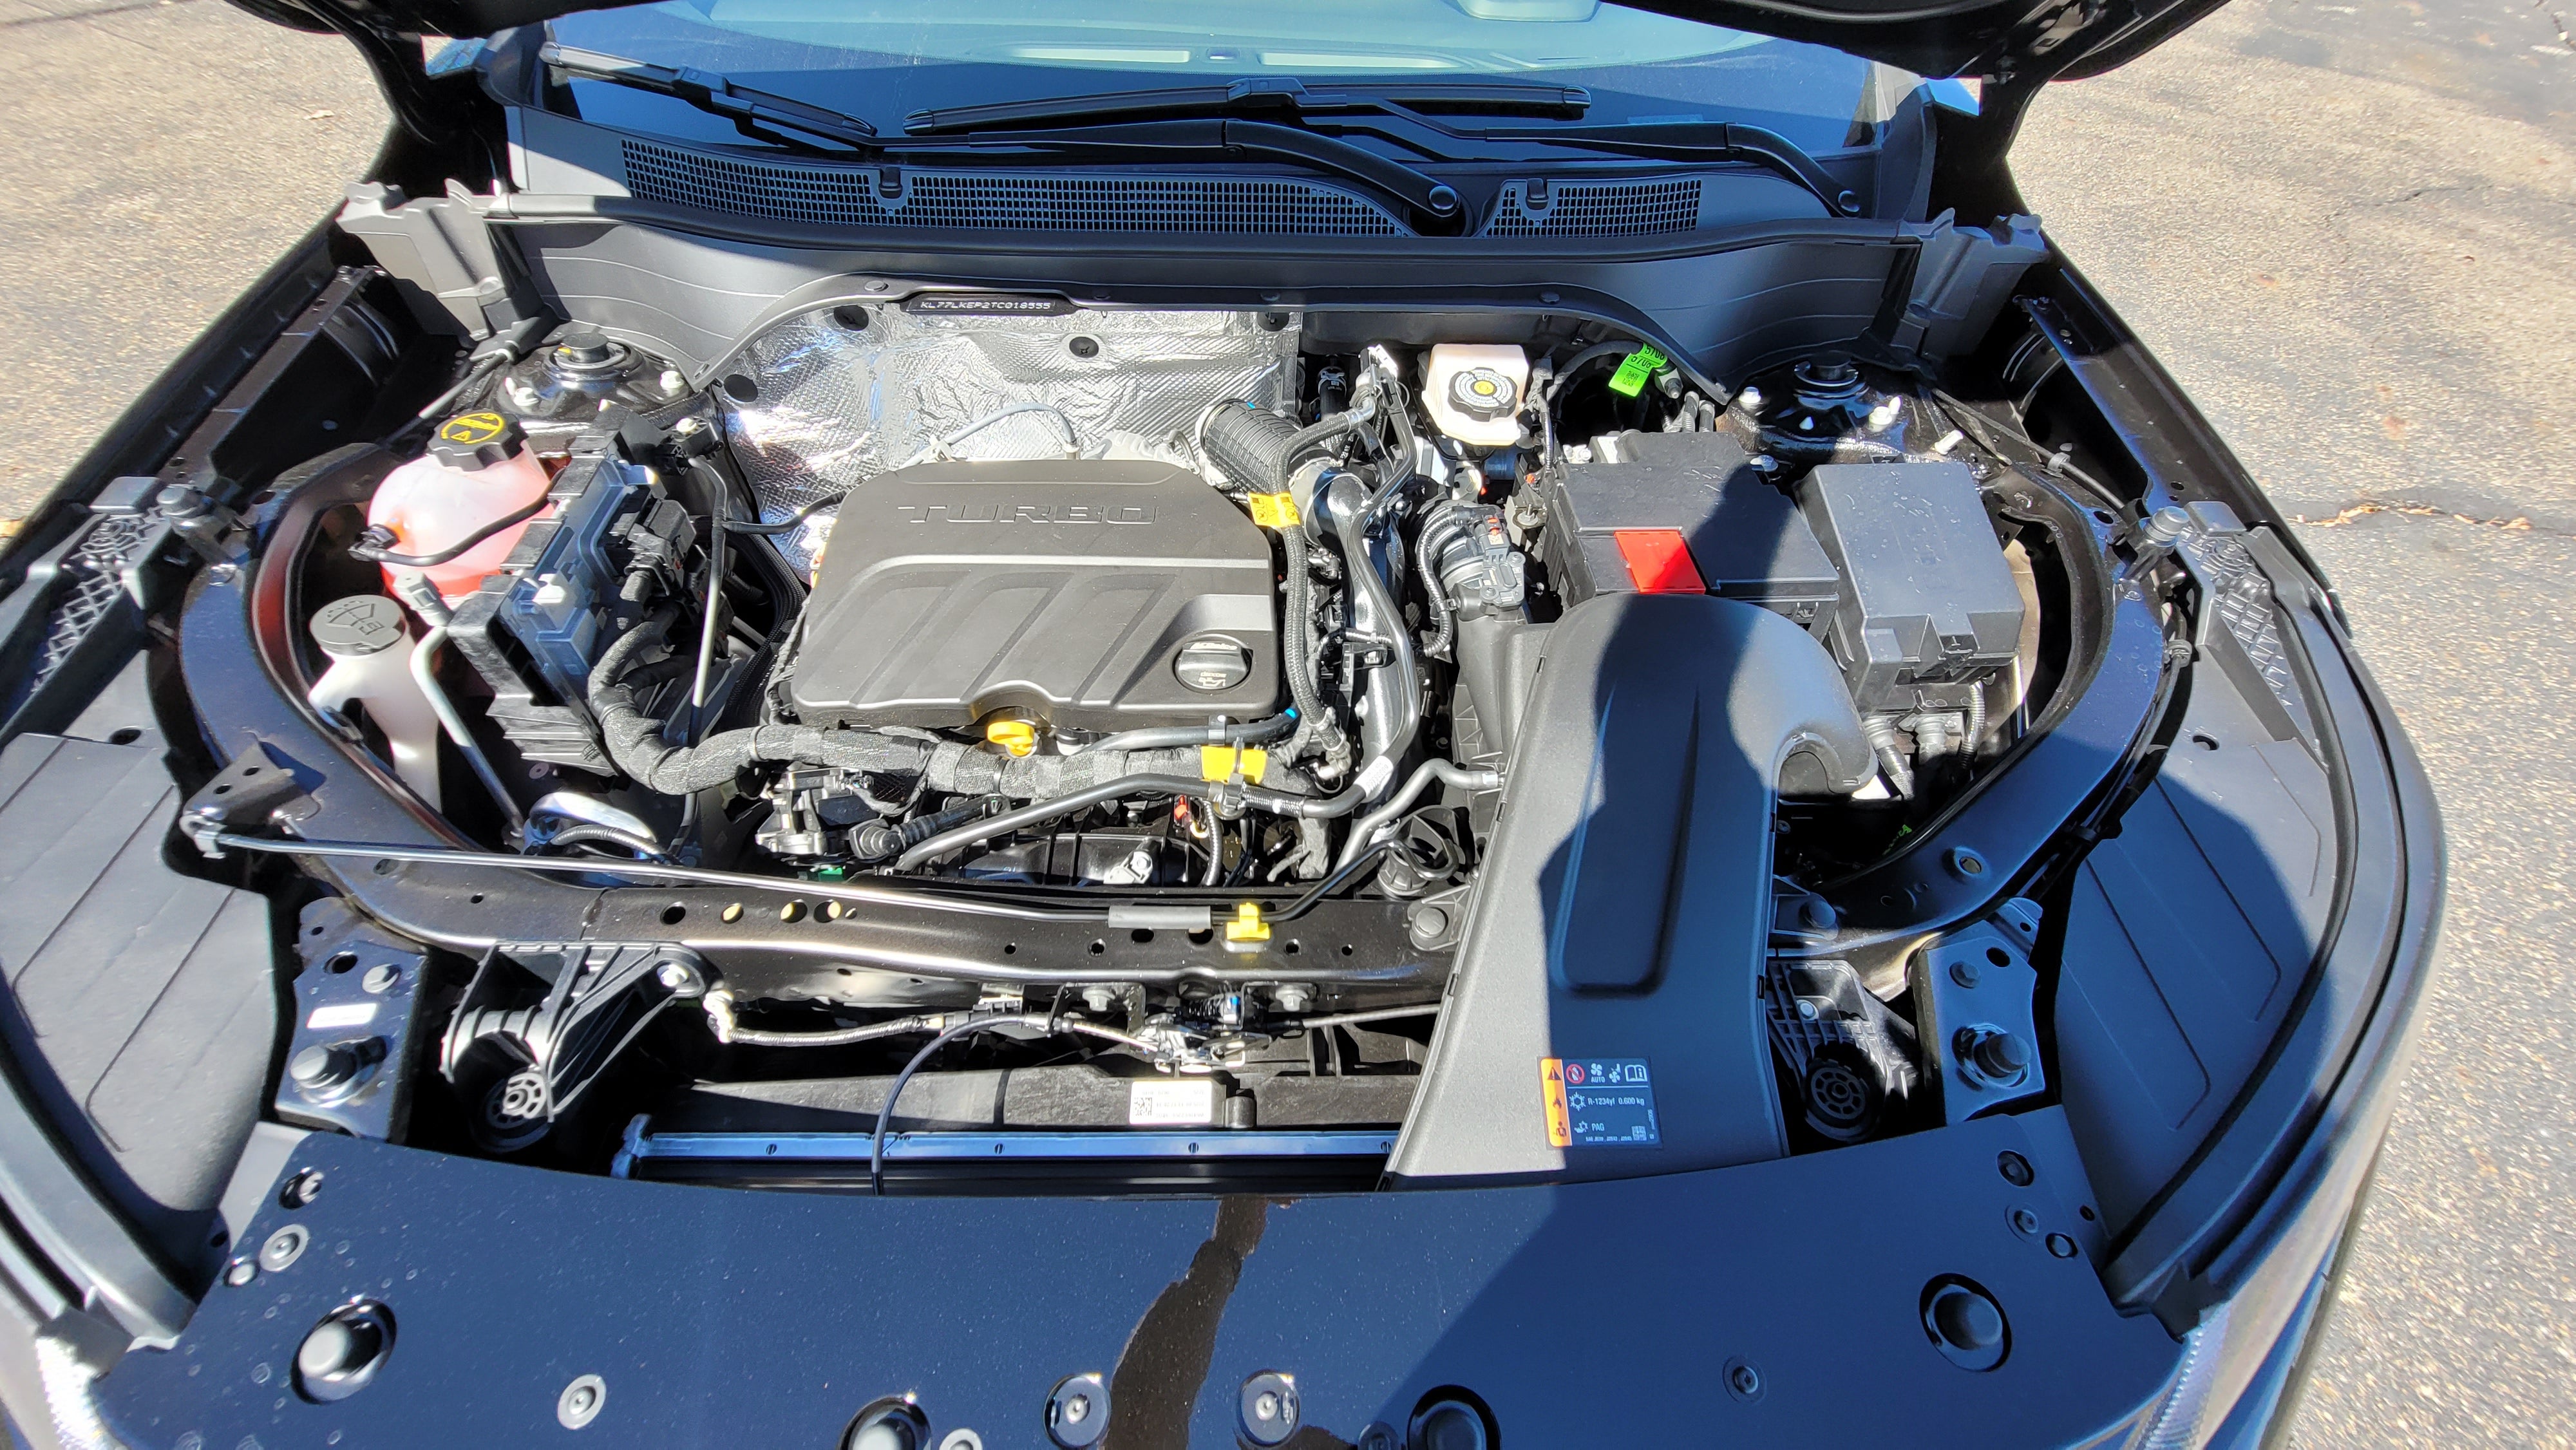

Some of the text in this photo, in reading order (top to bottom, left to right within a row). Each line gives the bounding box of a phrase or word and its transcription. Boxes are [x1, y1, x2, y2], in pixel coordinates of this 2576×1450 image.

[898, 505, 1157, 524] TURBO
[1587, 1097, 1615, 1107] R-1234yf
[1636, 1097, 1645, 1106] kg
[1591, 1123, 1605, 1131] PAG
